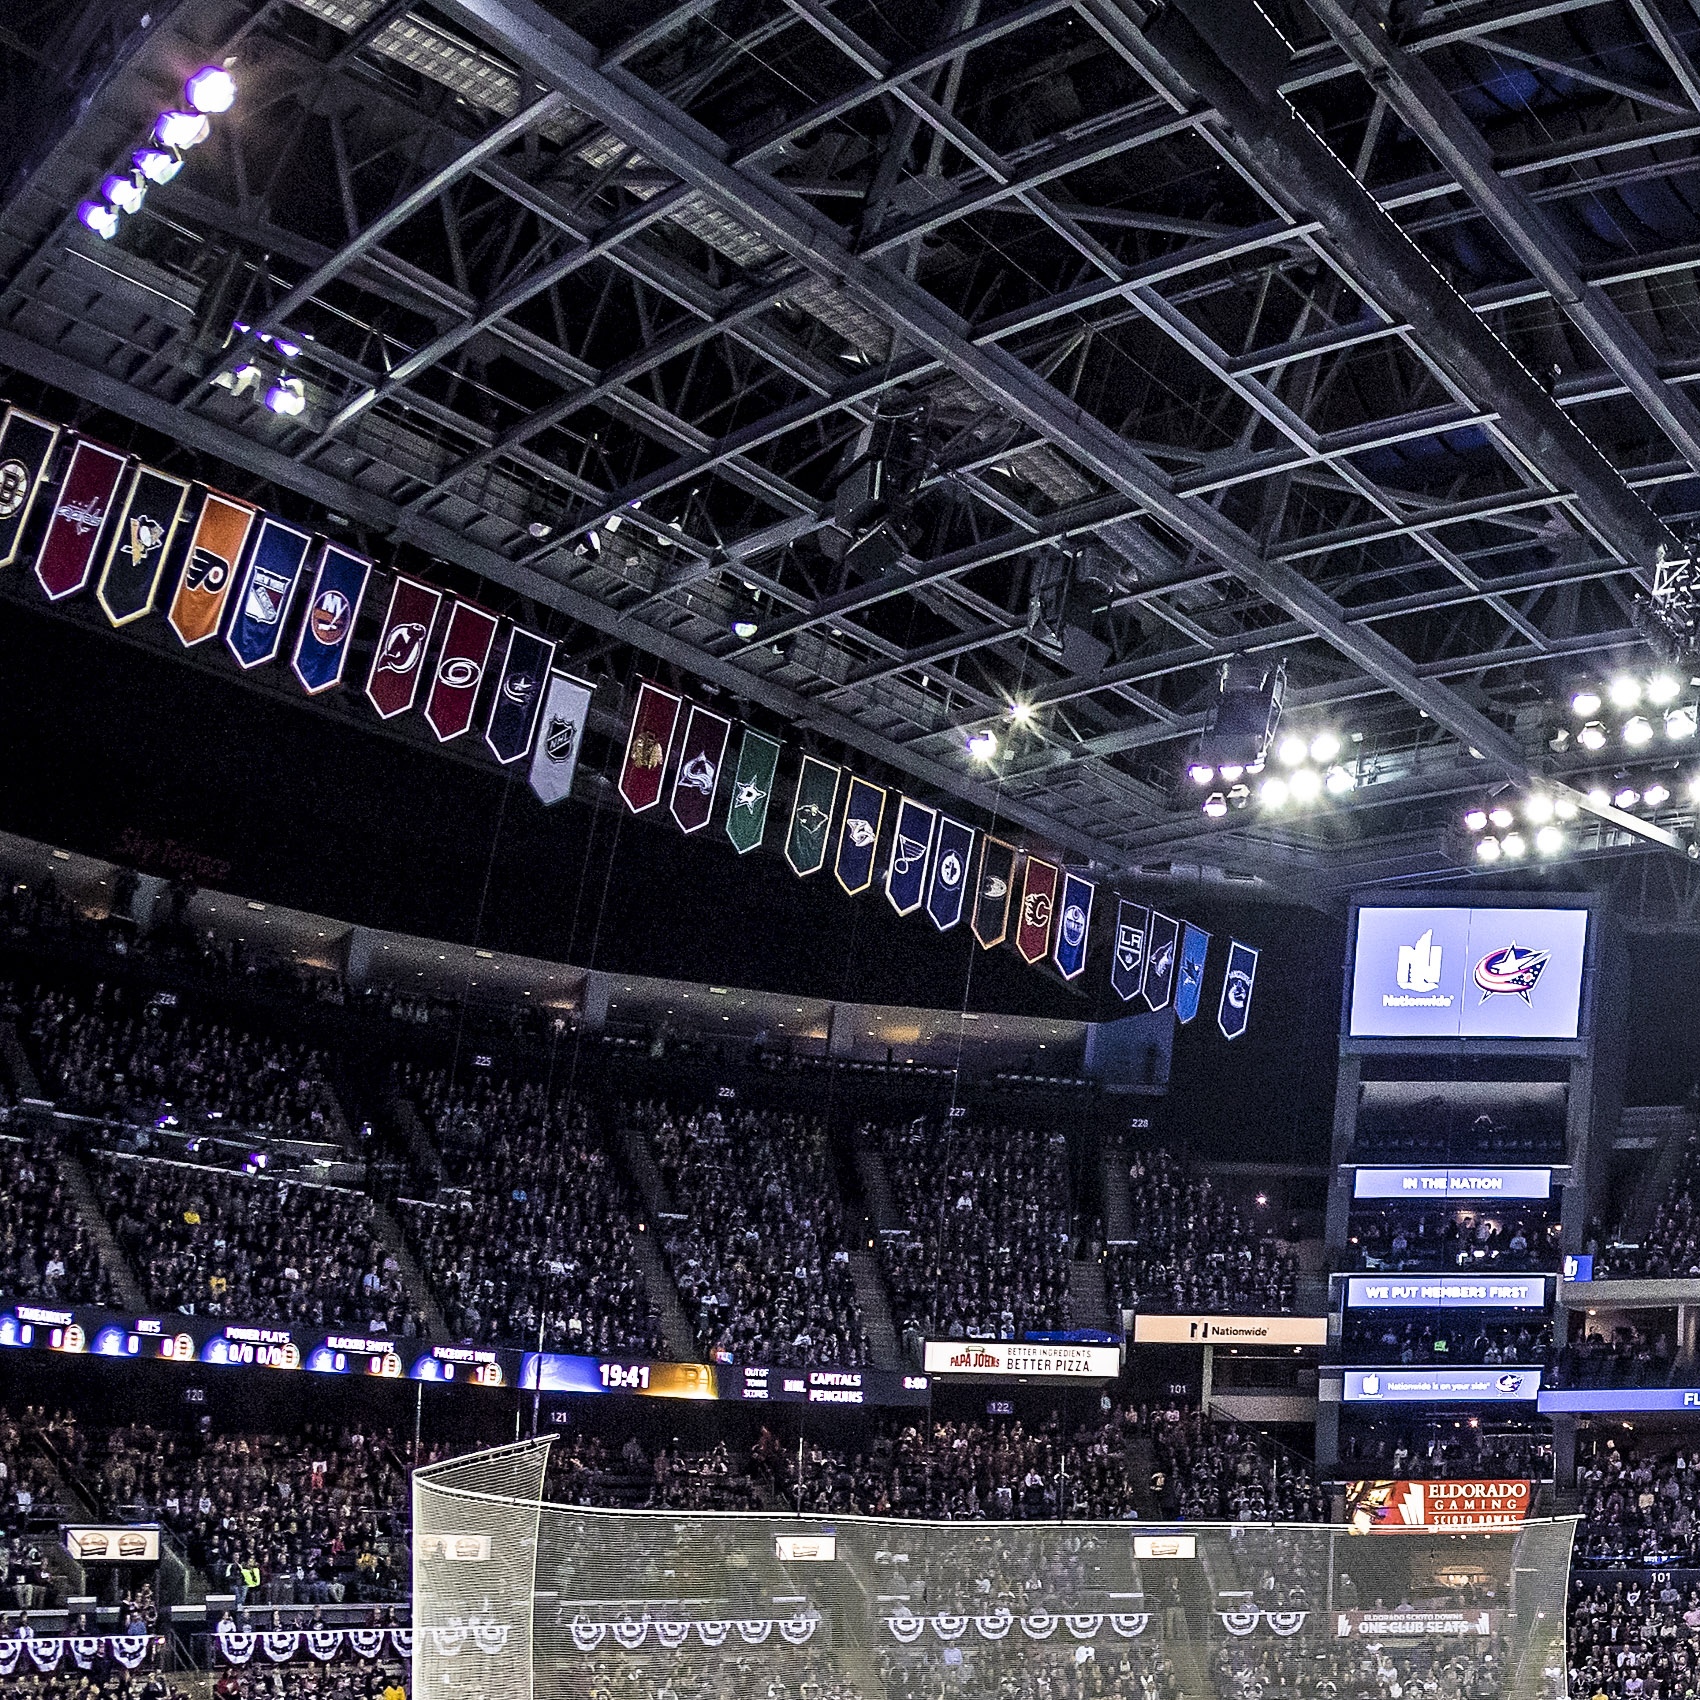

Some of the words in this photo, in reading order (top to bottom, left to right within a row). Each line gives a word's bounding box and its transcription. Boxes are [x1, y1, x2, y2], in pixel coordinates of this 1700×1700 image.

[1403, 1178, 1418, 1189] IN
[1420, 1178, 1448, 1189] THE
[1450, 1178, 1503, 1189] NATION
[1365, 1286, 1390, 1299] WE
[1391, 1286, 1419, 1299] PUT
[1421, 1286, 1487, 1299] MEMBERS
[1489, 1286, 1529, 1299] FIRST
[136, 1319, 161, 1334] HITS
[1212, 1326, 1268, 1337] Nationwide
[224, 1327, 260, 1343] POWER
[261, 1330, 291, 1344] PLAYS
[229, 1344, 254, 1363] 0/0
[1008, 1347, 1038, 1358] BETTER
[951, 1356, 973, 1369] PAPA
[1008, 1359, 1052, 1372] BETTER
[1055, 1360, 1093, 1373] PIZZA.
[600, 1364, 650, 1388] 19:41
[809, 1373, 861, 1387] CAPITALS
[1170, 1384, 1187, 1394] 101
[809, 1389, 864, 1403] PENGUINS
[550, 1411, 567, 1423] 121
[1428, 1483, 1527, 1499] ELDORADO
[1434, 1499, 1517, 1510] GAMING
[1651, 1571, 1671, 1583] 101
[1360, 1622, 1387, 1634] ONE
[1389, 1622, 1424, 1634] CLUB
[1426, 1622, 1469, 1634] SEATS
